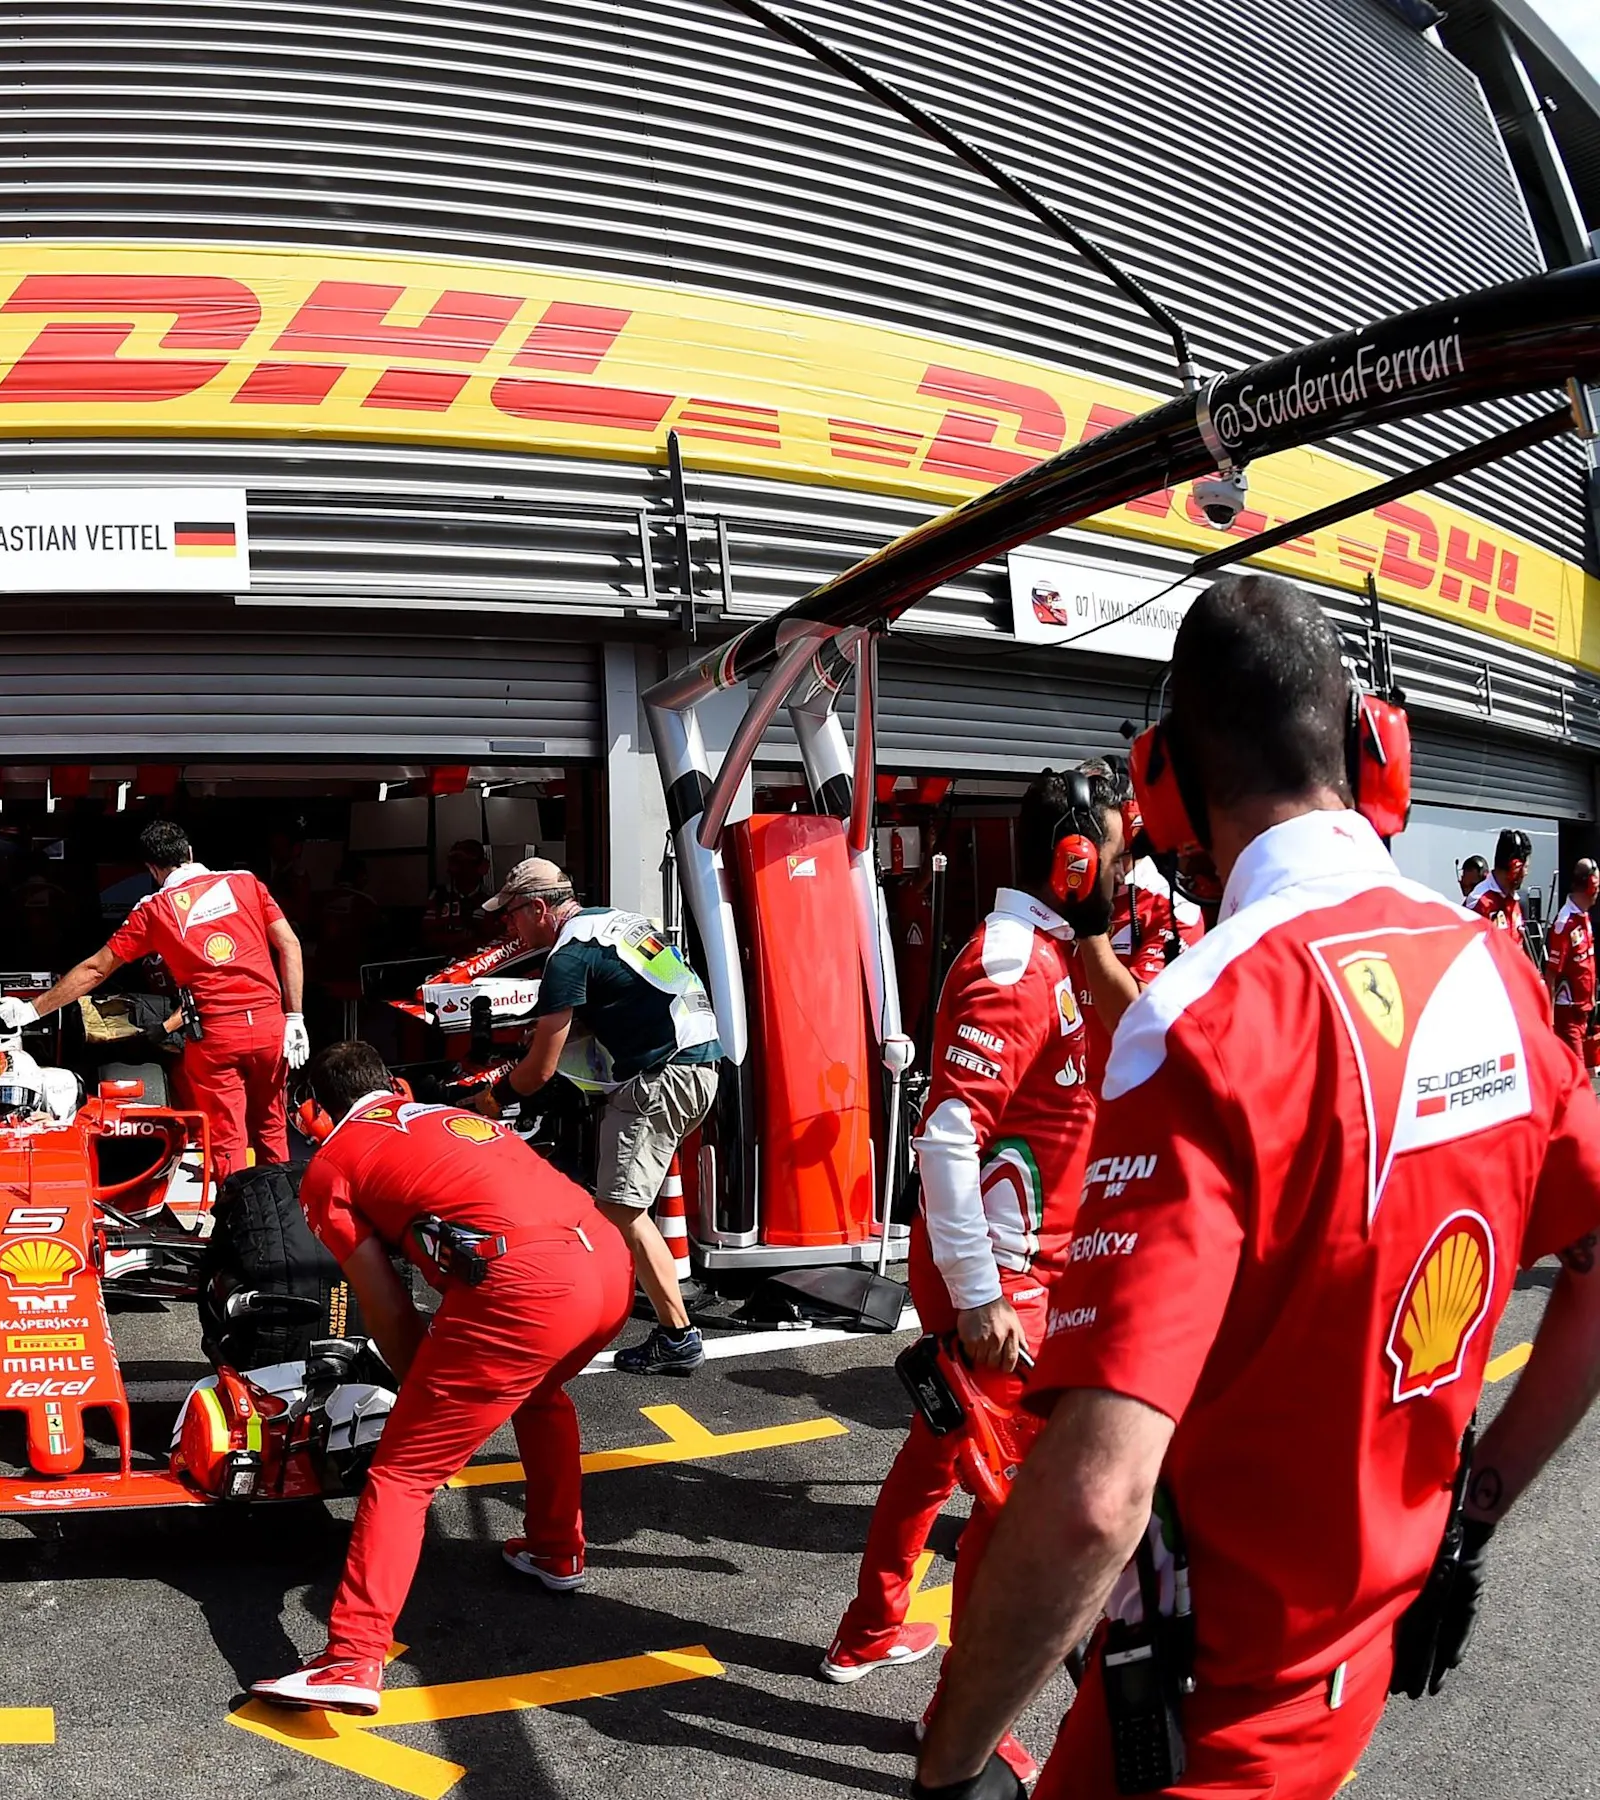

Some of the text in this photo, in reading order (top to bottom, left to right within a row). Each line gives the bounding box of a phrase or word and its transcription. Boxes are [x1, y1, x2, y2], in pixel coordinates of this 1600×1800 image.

[1213, 316, 1464, 448] @ScuderiaFerrari
[85, 521, 168, 552] VETTEL
[1373, 500, 1532, 631] DHL
[1075, 595, 1089, 617] 07
[466, 937, 520, 976] KASPERSKY
[460, 990, 534, 1011] Sander
[957, 1023, 1005, 1054] MAHLE
[945, 1044, 1002, 1080] PIRELLI
[1417, 1058, 1497, 1094] SCUDERIA
[1450, 1073, 1517, 1110] FERRARI
[100, 1119, 155, 1139] Claro
[1083, 1154, 1158, 1188] EICHAI
[1, 1206, 70, 1235] 5
[1066, 1227, 1130, 1267] PERSKY
[6, 1294, 77, 1311] TNT
[328, 1286, 340, 1336] SINISTRA
[336, 1280, 348, 1339] ANTERIORE
[0, 1316, 83, 1331] KASPERSKY
[13, 1336, 78, 1349] PIRELLI
[2, 1355, 95, 1374] MAHLE
[4, 1376, 97, 1399] telcel
